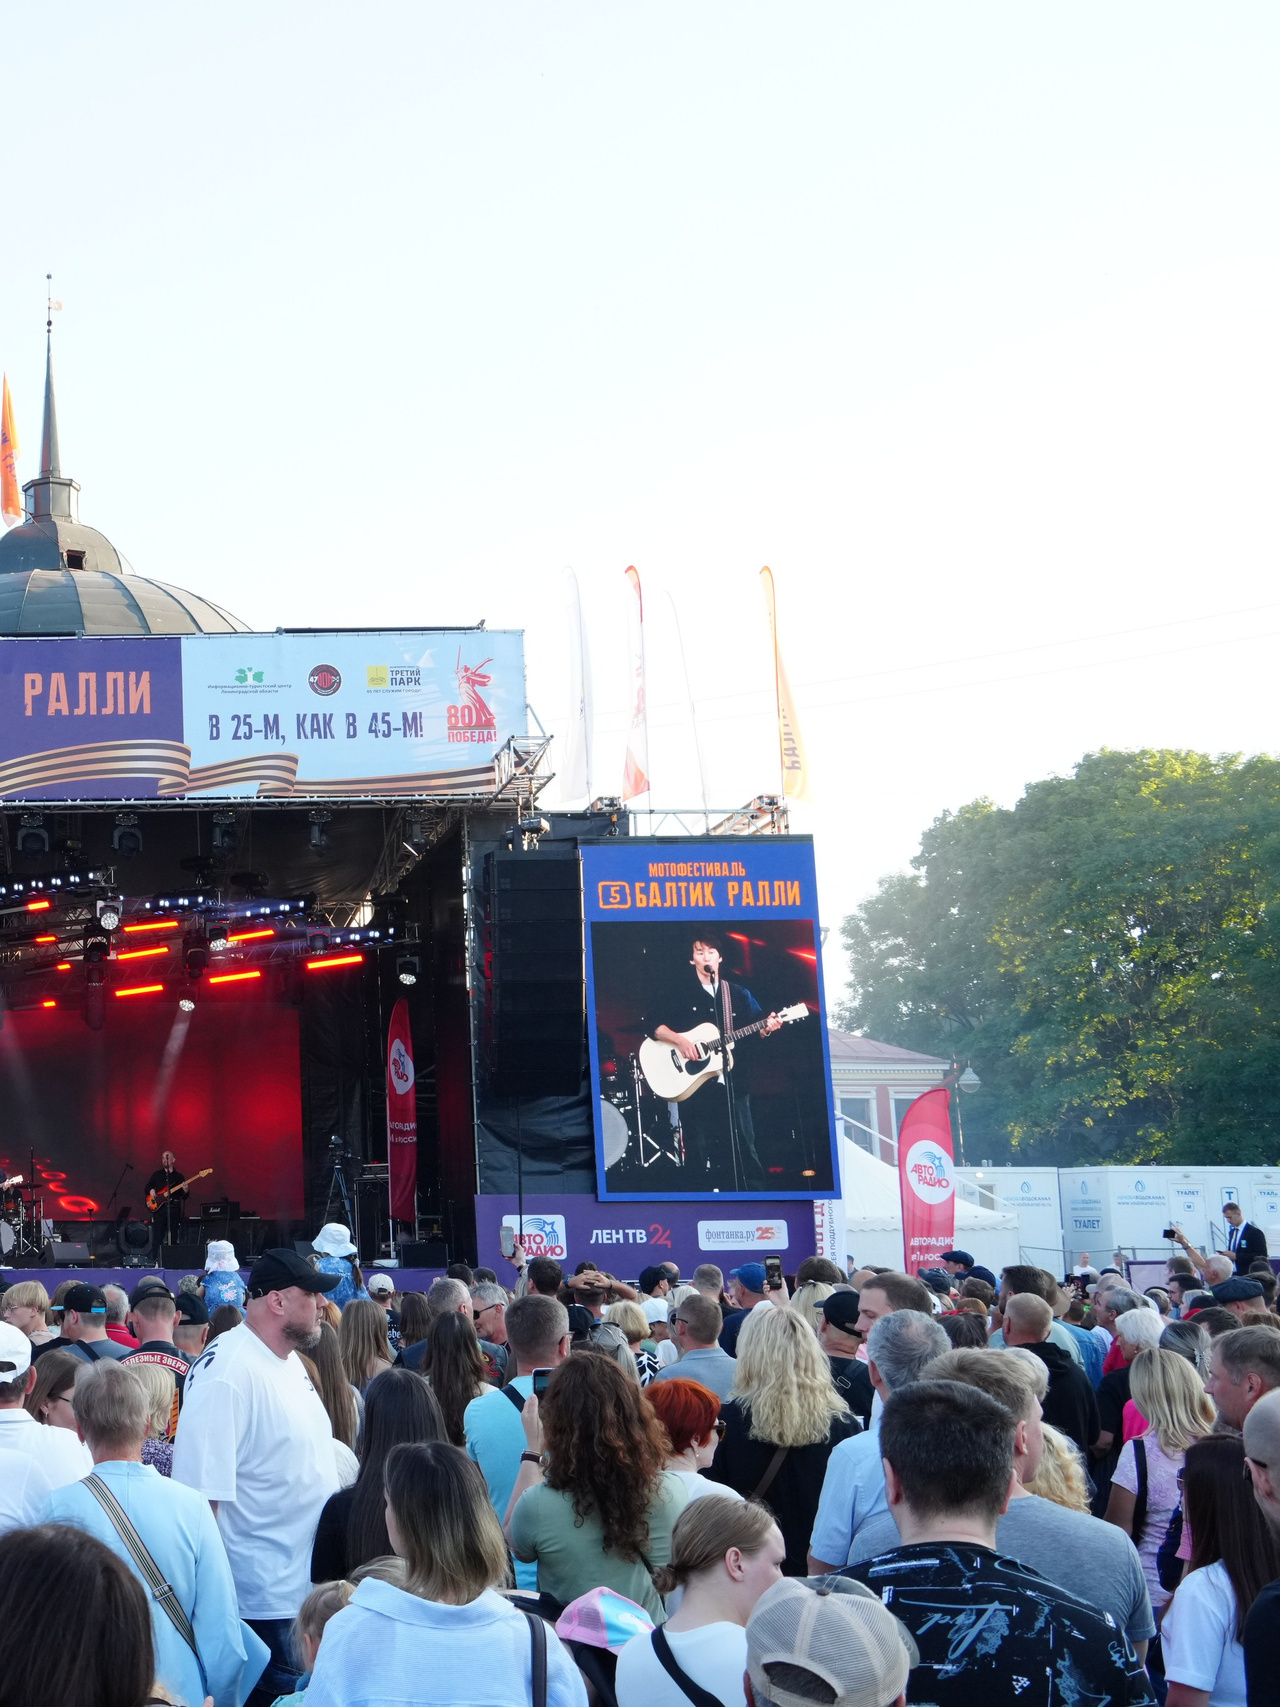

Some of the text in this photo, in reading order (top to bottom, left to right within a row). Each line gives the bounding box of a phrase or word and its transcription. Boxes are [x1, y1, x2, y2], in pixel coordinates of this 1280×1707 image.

[390, 667, 421, 677] ТРЕТИЙ
[390, 677, 421, 686] ПАРК
[24, 670, 151, 717] РАЛЛИ
[446, 704, 472, 727] 80
[208, 711, 424, 746] В 25-М, КАК В 45-М!
[447, 729, 497, 744] ПОБЕДА!
[648, 861, 746, 878] МОТОФЕСТИВАЛЬ
[609, 880, 801, 908] 5 БАЛТИК РАЛЛИ
[910, 1163, 934, 1176] АВТО
[917, 1175, 950, 1189] РАДИО
[826, 1199, 837, 1251] ПОДДУБНОГО
[1073, 1219, 1100, 1229] ТУАЛЕТ
[590, 1223, 672, 1249] ЛЕН ТВ 24
[705, 1229, 756, 1244] фонтанка.ру
[162, 1356, 187, 1371] ЗВЕРИ
